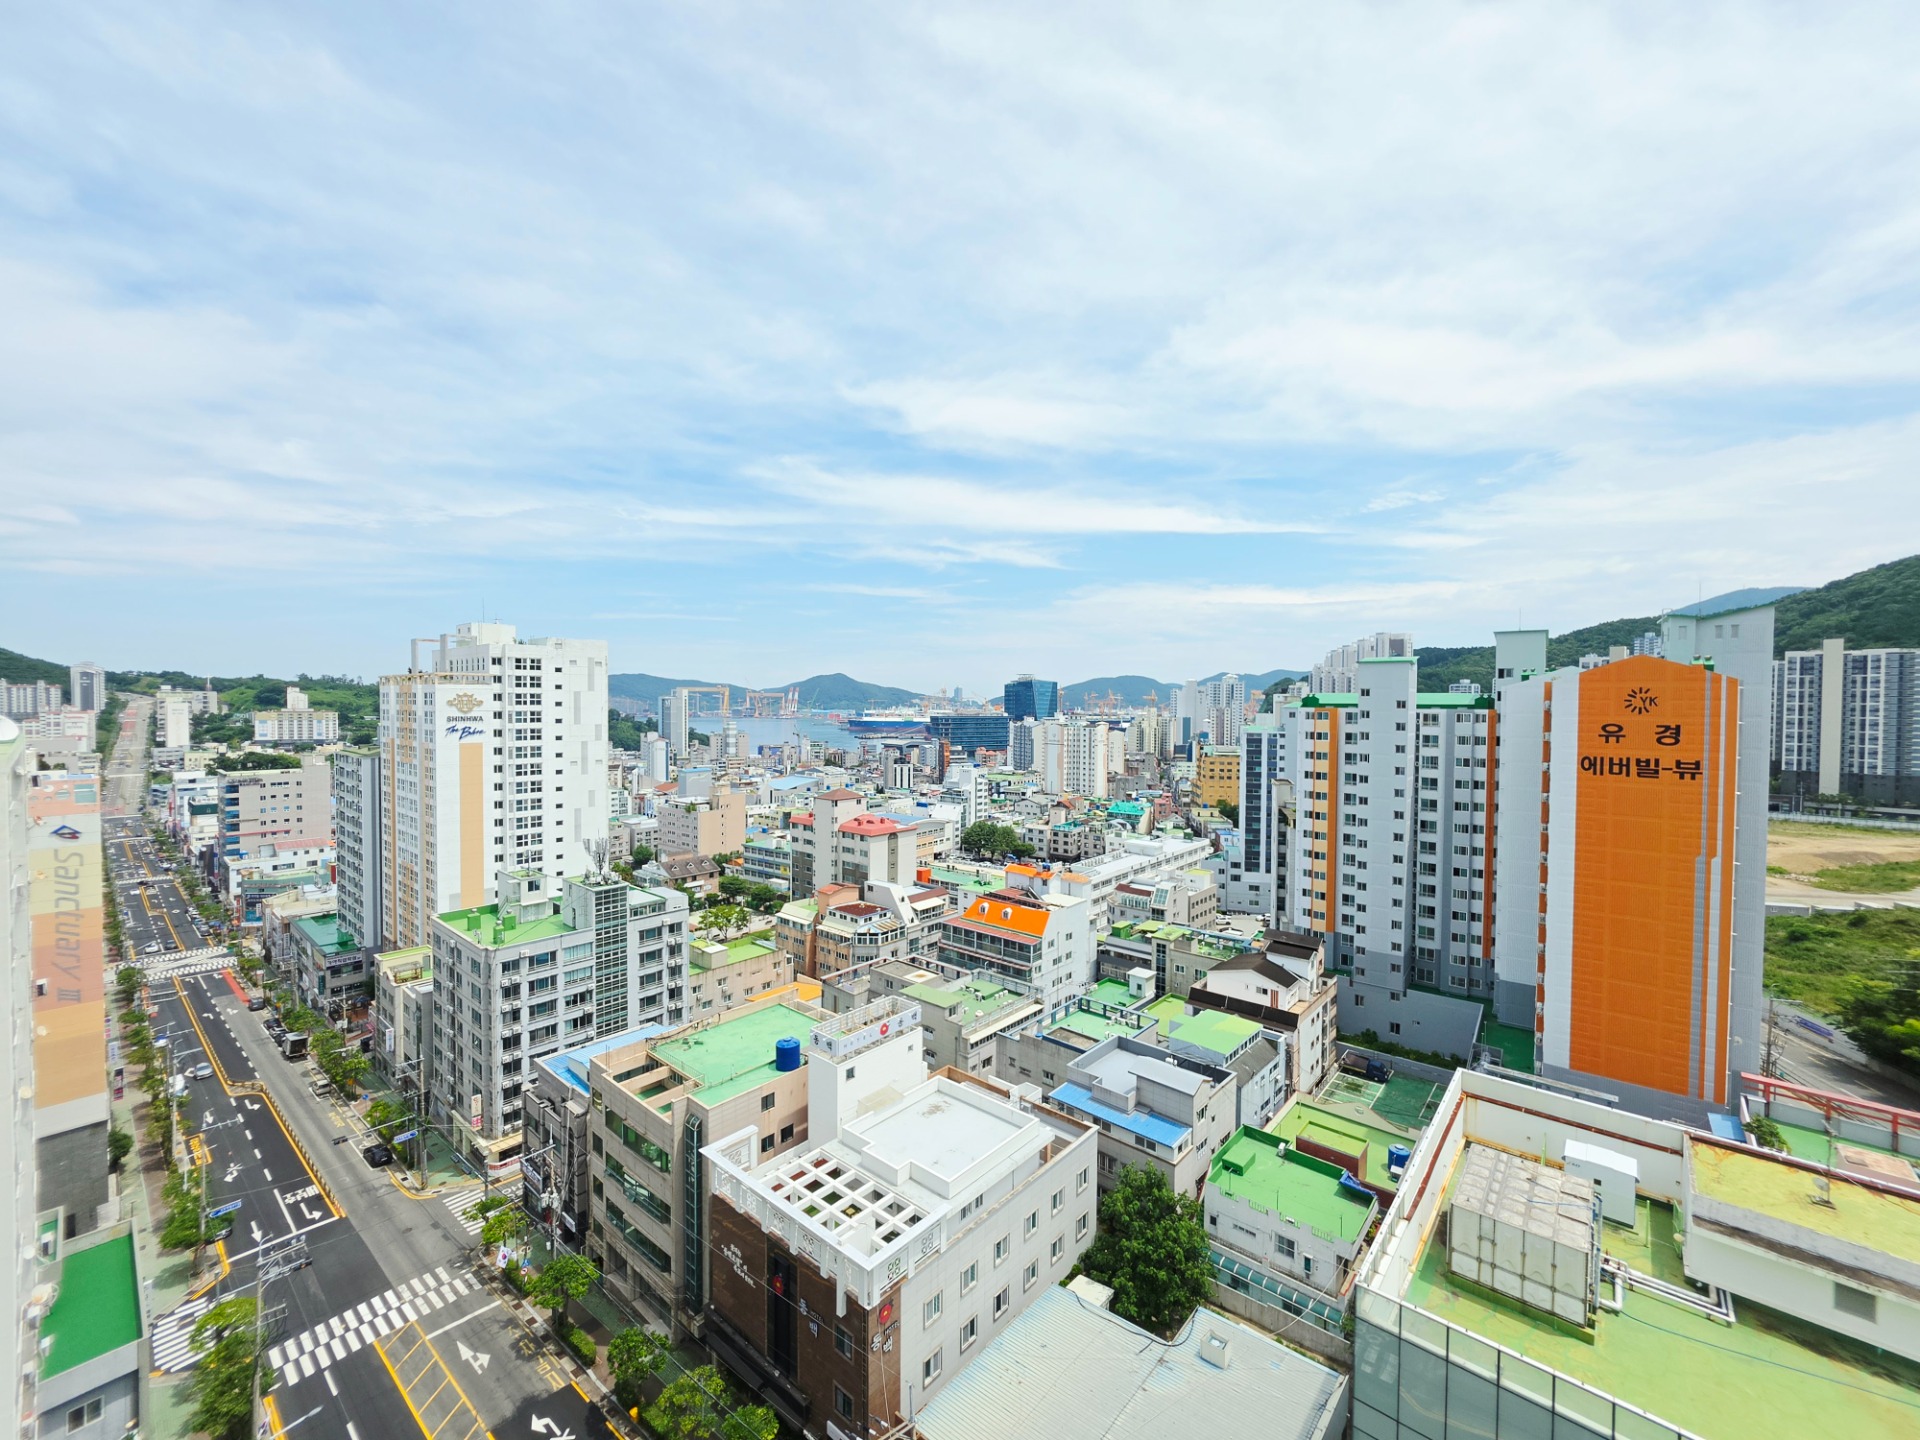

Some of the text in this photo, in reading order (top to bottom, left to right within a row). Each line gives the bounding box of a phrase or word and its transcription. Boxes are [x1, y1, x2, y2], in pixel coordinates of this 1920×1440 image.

[1640, 696, 1659, 707] YK
[446, 715, 484, 723] SHINHWA
[1580, 756, 1704, 780] 에버빌-뷰
[52, 848, 84, 983] Sanctuary
[282, 1184, 321, 1205] 비보호
[870, 1332, 894, 1354] 동백
